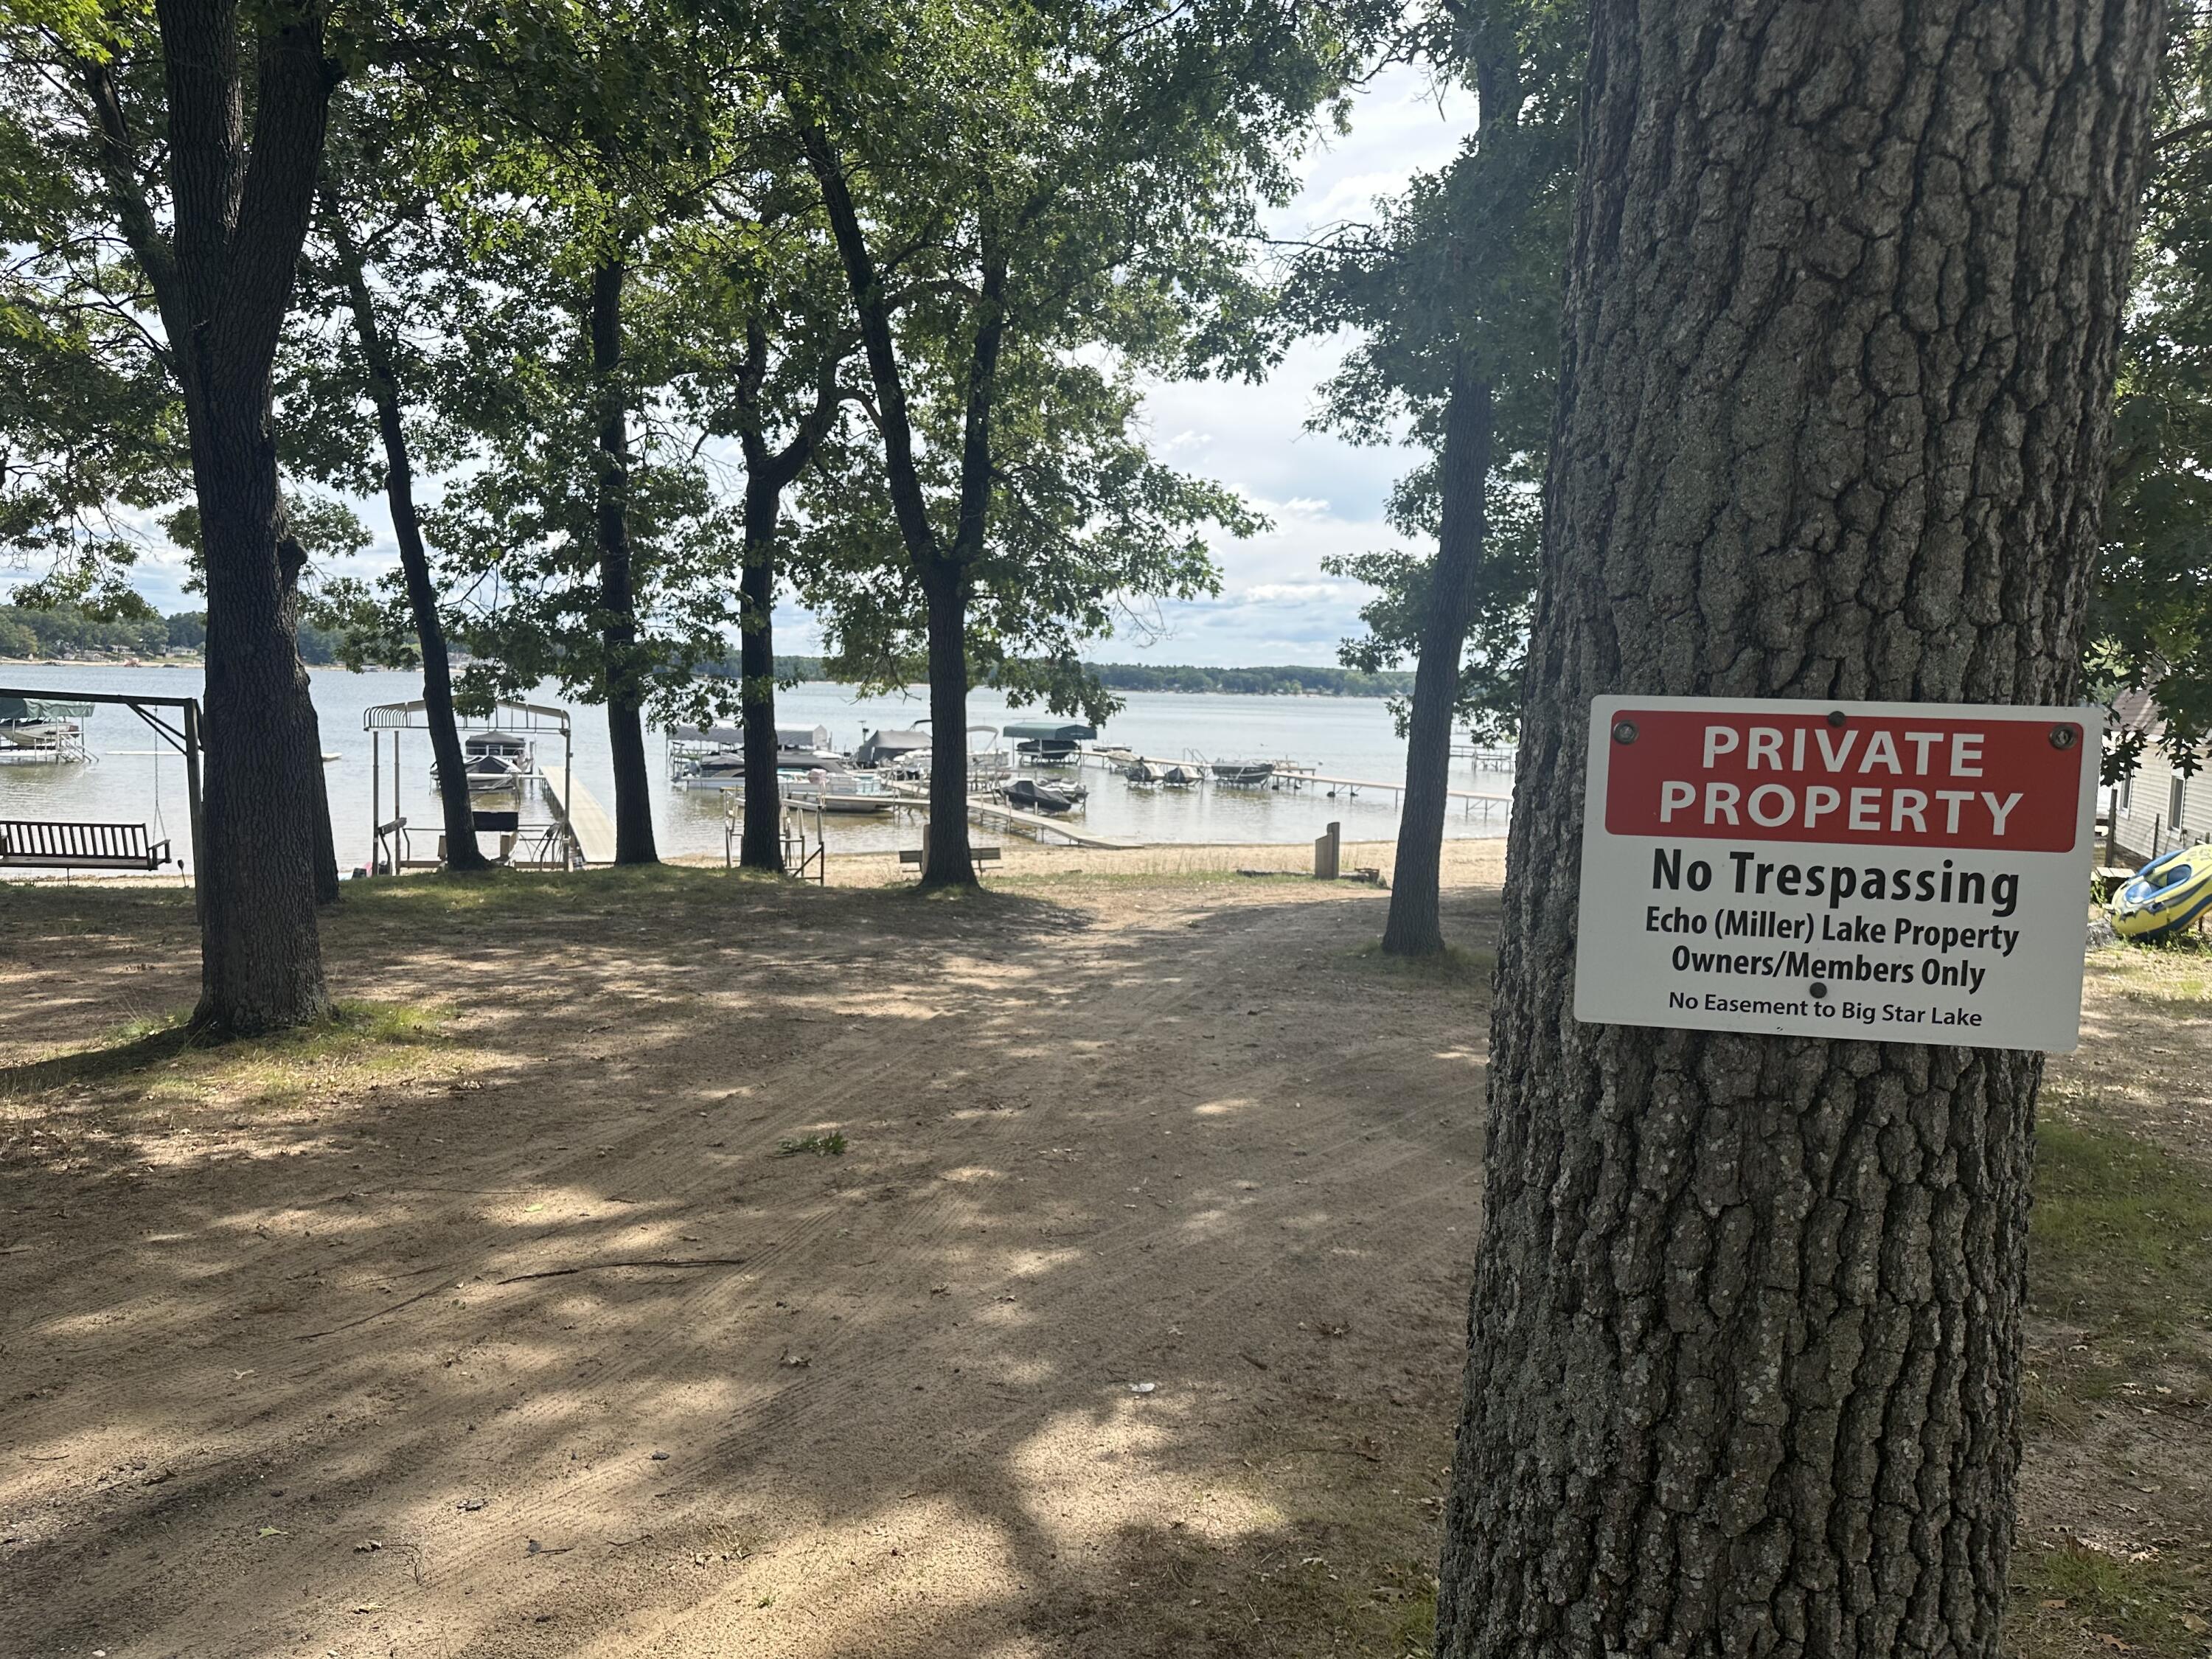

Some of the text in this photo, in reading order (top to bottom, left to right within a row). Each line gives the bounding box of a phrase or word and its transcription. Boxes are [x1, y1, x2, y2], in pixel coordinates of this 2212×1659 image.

[1703, 726, 1984, 776] PRIVATE
[1660, 781, 2023, 835] PROPERTY
[1653, 849, 2019, 917] No Trespassing
[1646, 906, 2020, 957] Echo (Miller) Lake Property
[1672, 945, 1986, 995] Owners/Members Only
[1669, 992, 1983, 1027] No Easement to Big Star Lake
